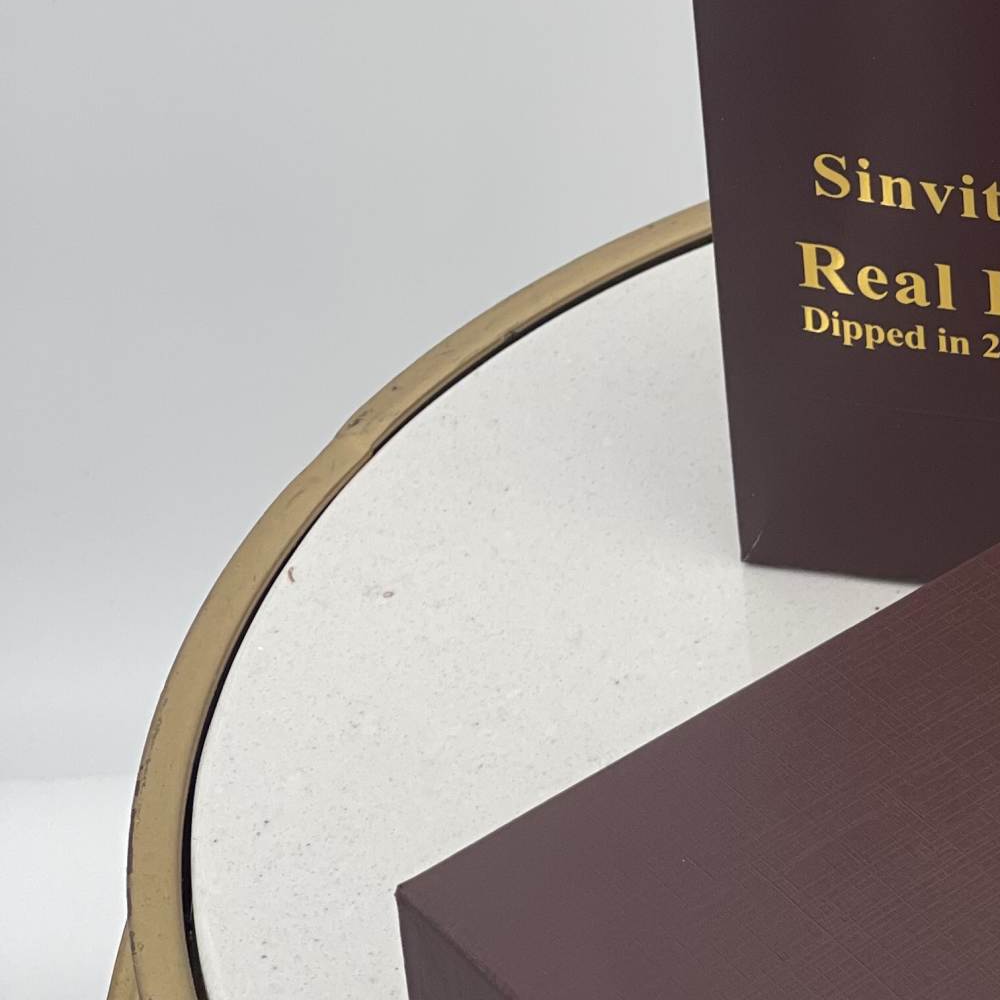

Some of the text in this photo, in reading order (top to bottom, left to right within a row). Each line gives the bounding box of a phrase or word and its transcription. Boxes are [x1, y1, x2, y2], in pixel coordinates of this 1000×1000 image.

[796, 241, 957, 311] Real
[801, 305, 927, 350] Dipped
[937, 328, 970, 356] in
